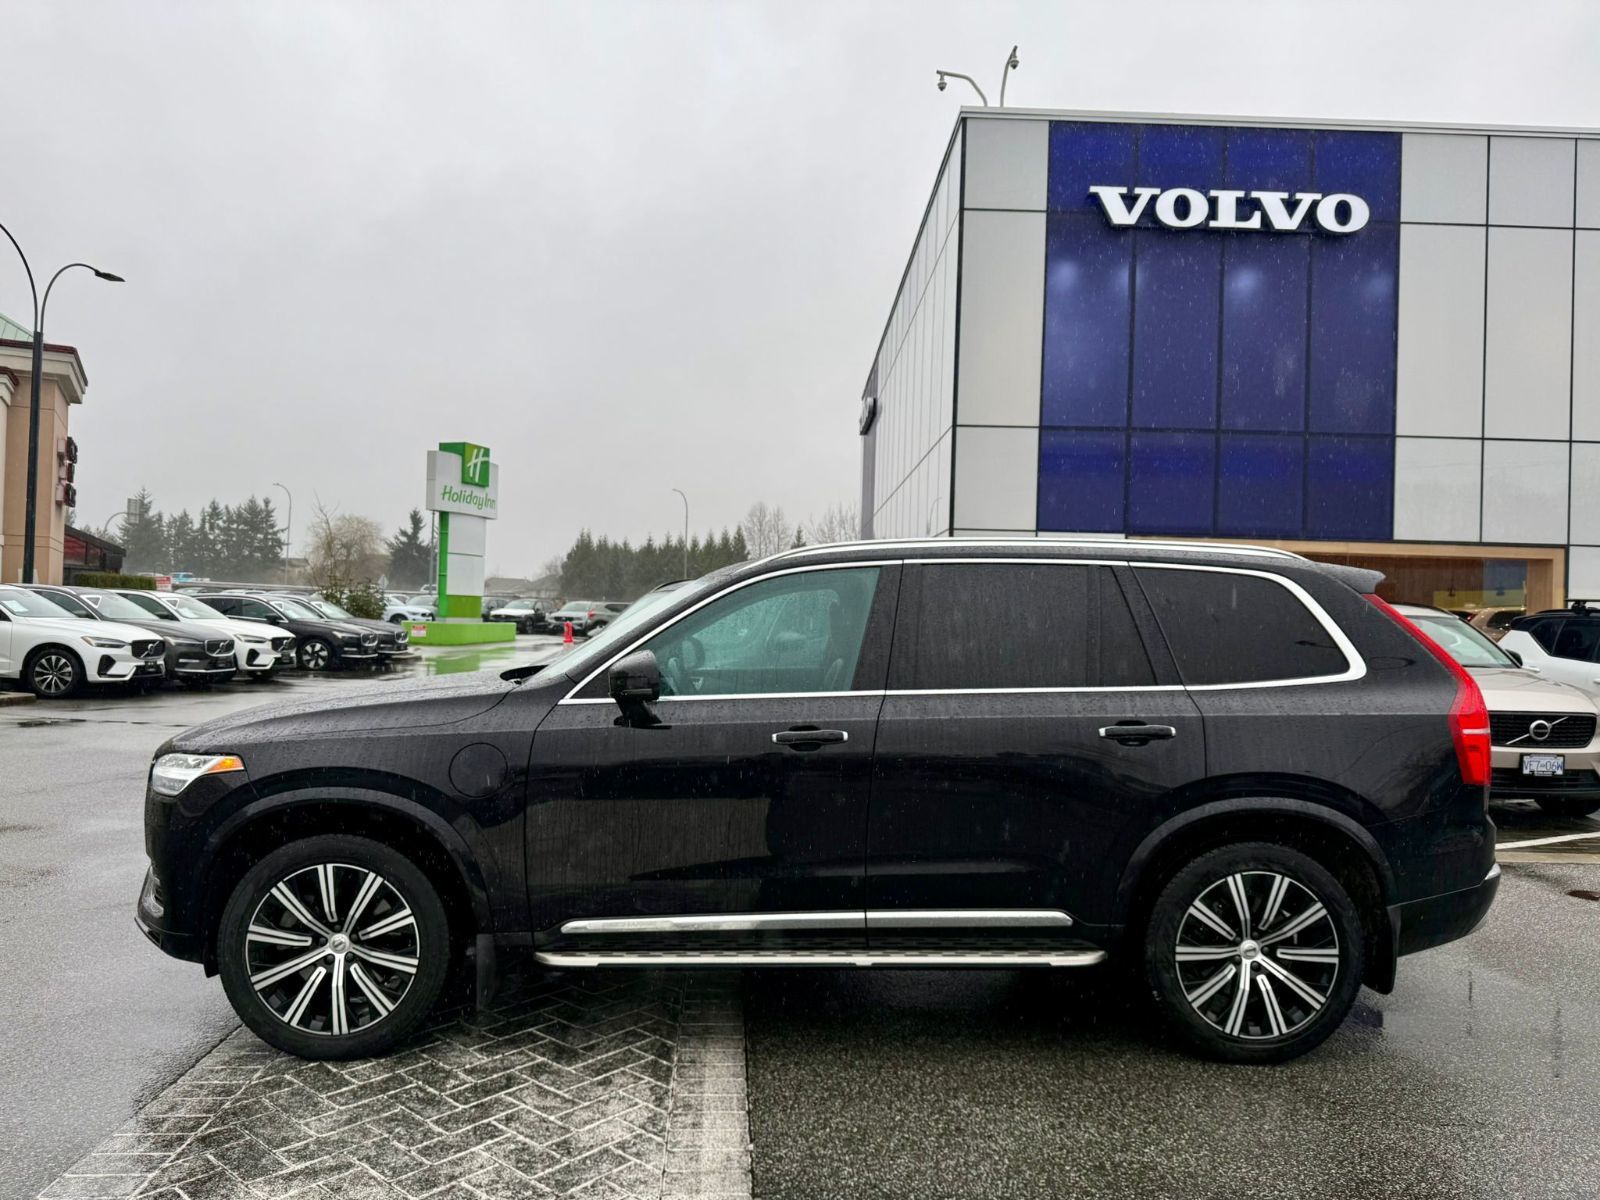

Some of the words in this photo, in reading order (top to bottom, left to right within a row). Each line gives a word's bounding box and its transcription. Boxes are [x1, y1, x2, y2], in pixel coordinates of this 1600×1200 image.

[1089, 185, 1370, 233] VOLVO
[441, 485, 483, 510] Holiday
[484, 492, 496, 509] Inn
